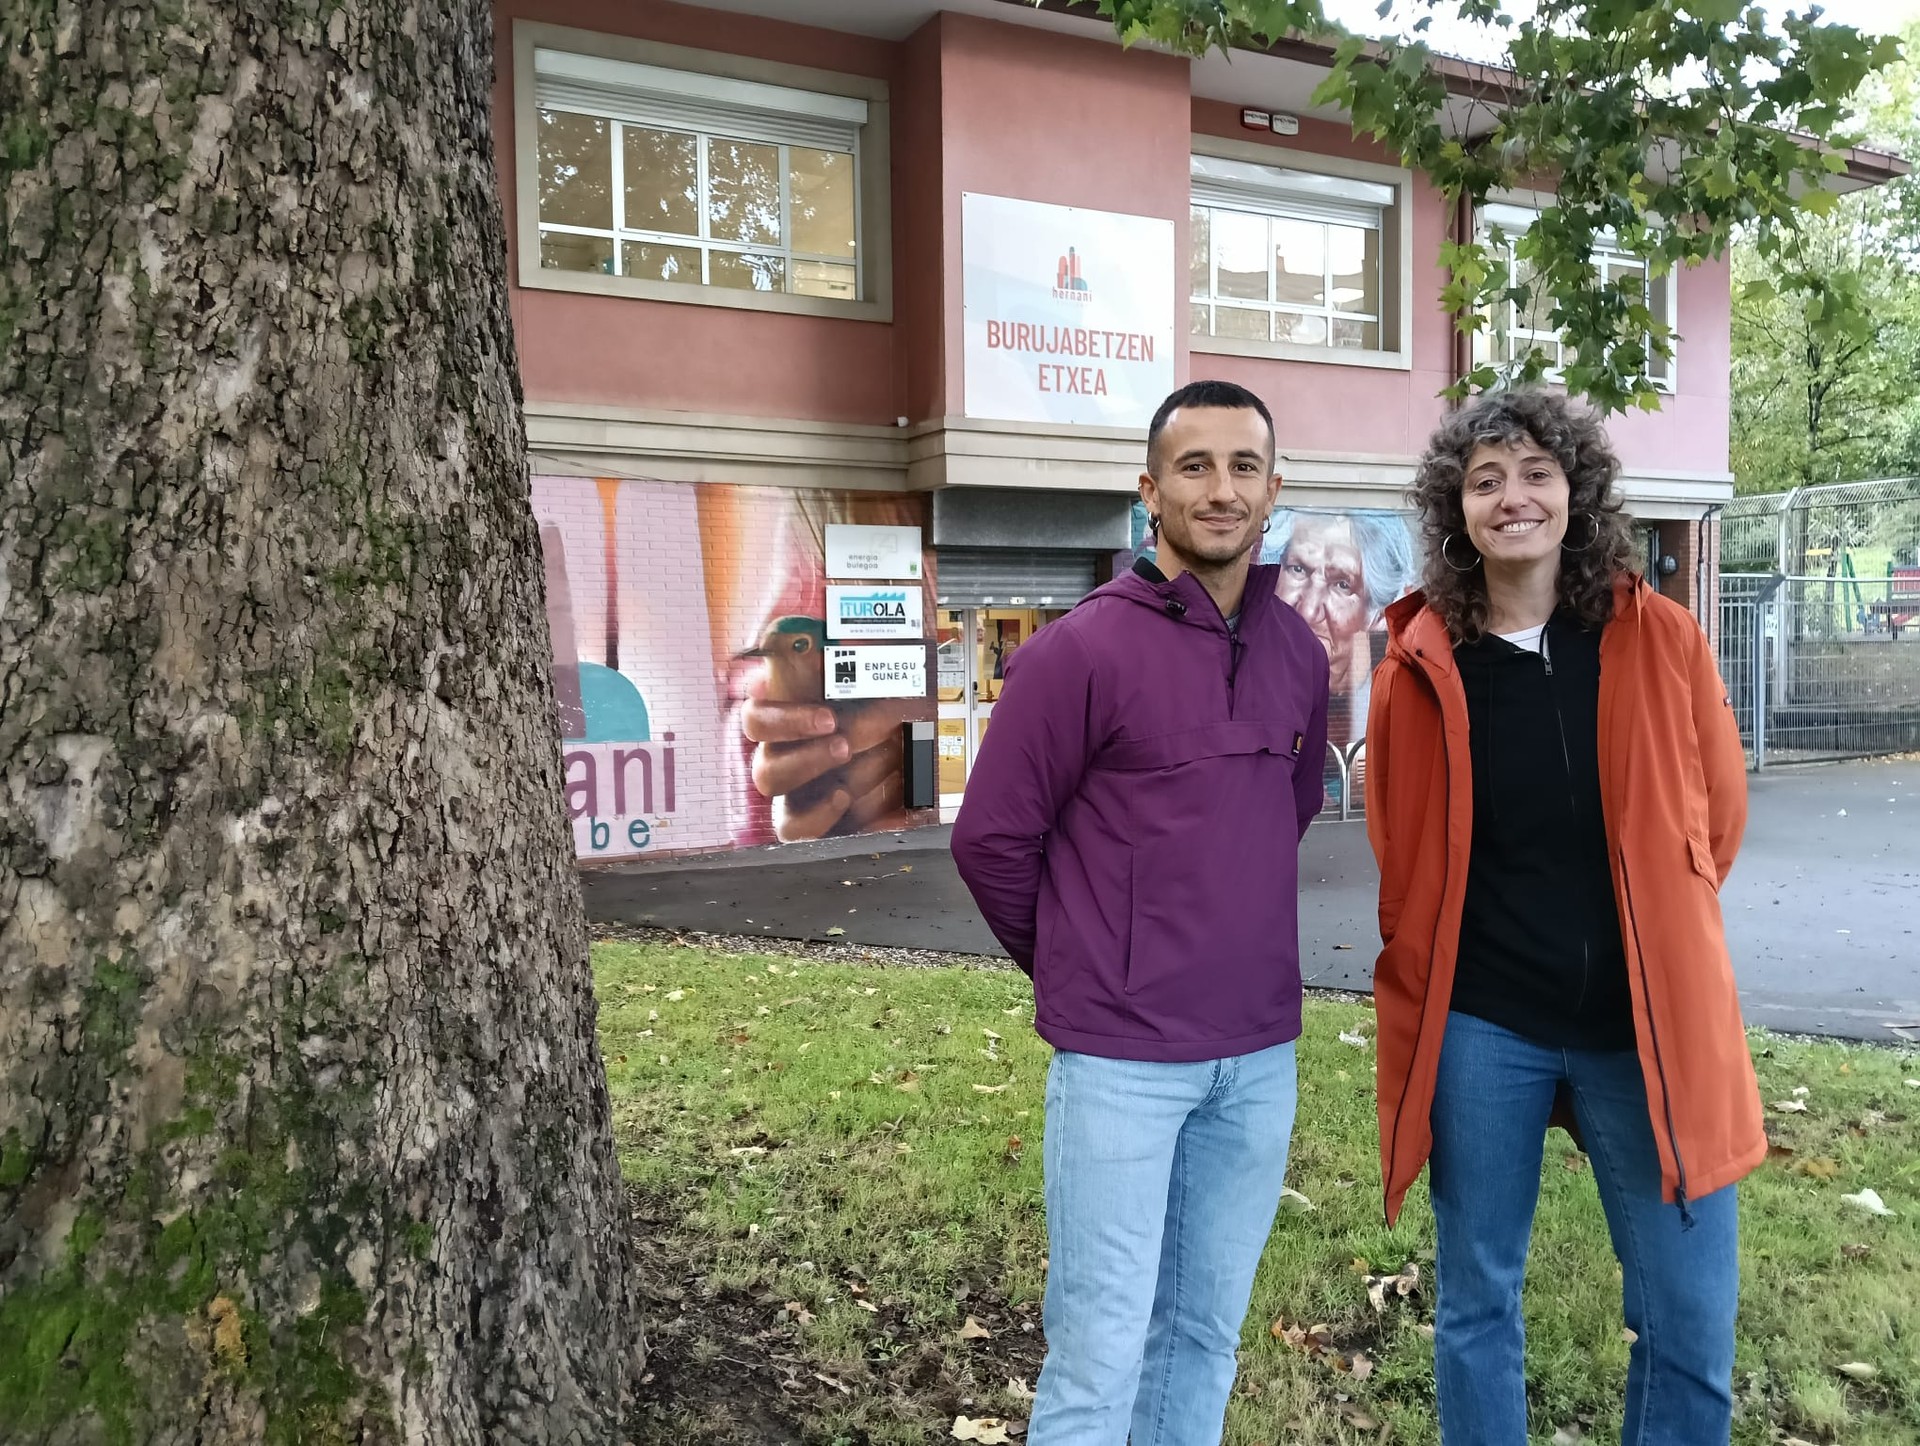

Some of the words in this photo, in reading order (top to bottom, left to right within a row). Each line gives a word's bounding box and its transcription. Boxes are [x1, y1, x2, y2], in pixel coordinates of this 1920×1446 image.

[1052, 286, 1092, 302] hernani
[987, 320, 1154, 362] BURUJABETZEN
[1038, 364, 1108, 396] ETXEA
[848, 554, 878, 562] energia
[847, 562, 878, 570] bulegoa
[840, 602, 905, 616] ITUROLA
[865, 662, 916, 671] ENPLEGU
[872, 672, 908, 681] GUNEA
